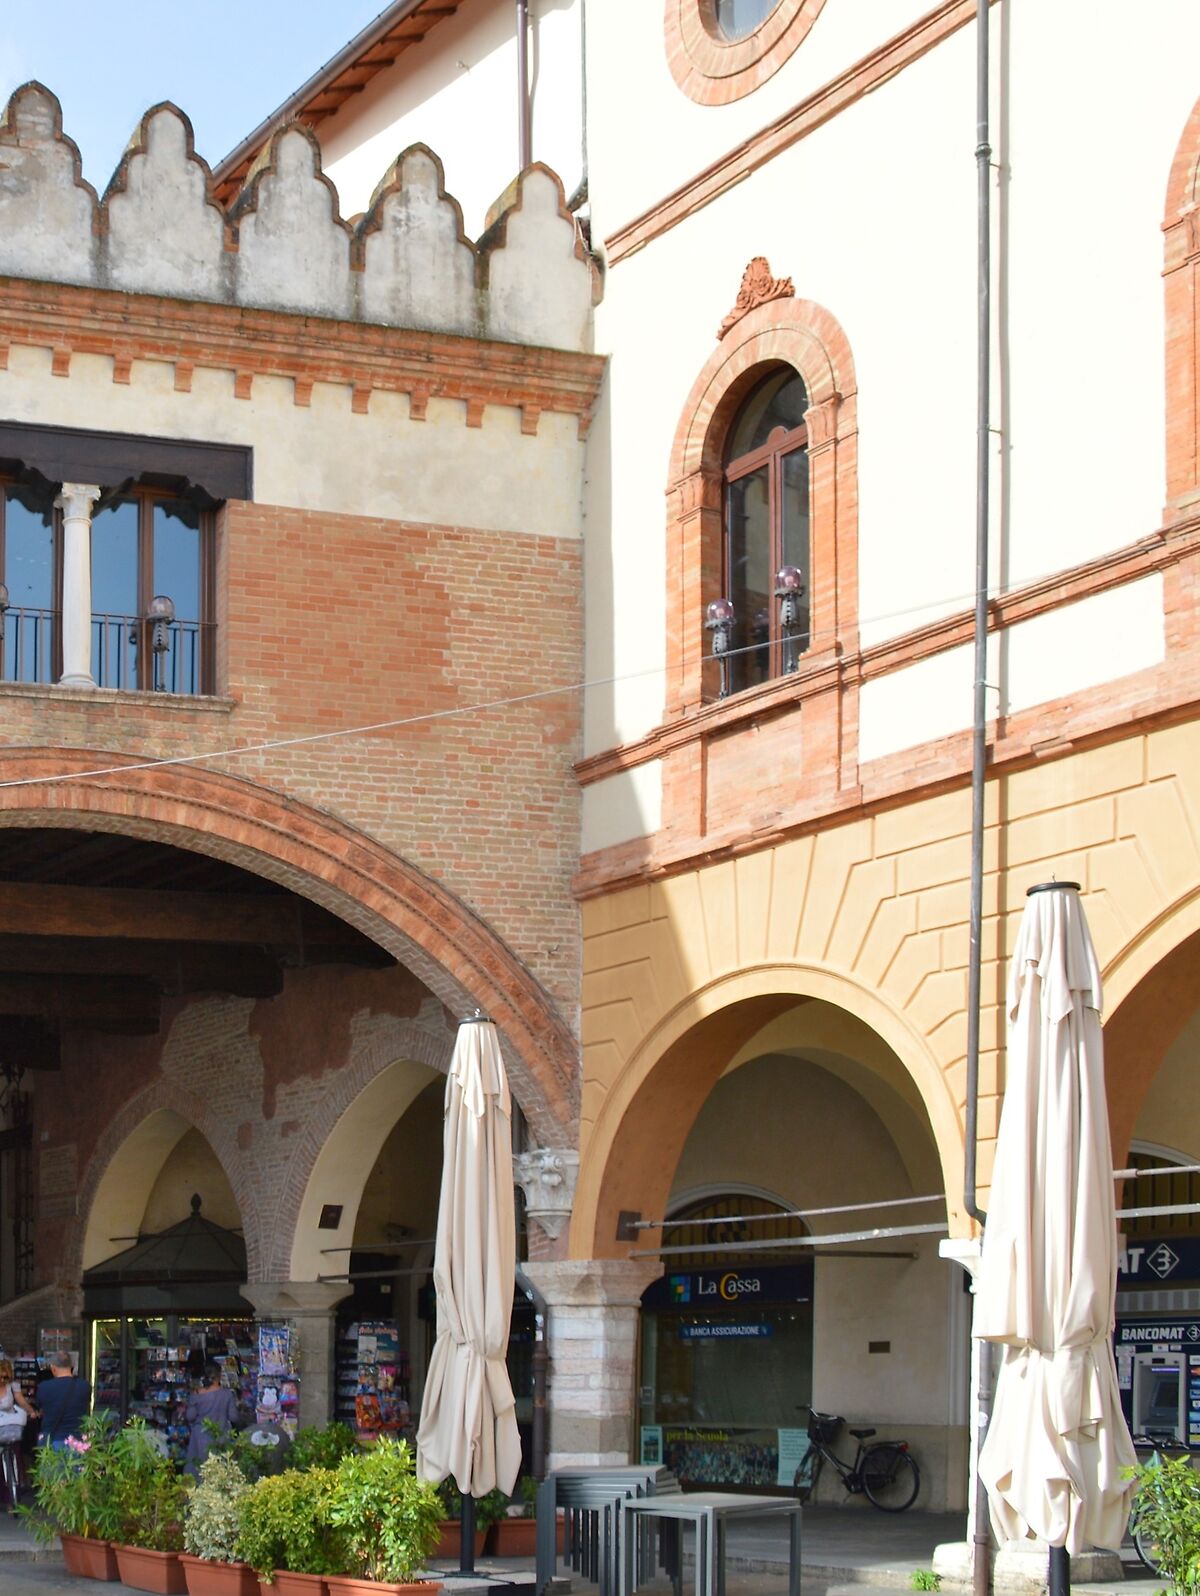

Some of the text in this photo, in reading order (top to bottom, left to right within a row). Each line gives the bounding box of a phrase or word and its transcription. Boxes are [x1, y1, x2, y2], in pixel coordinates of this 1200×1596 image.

[698, 1273, 761, 1300] La Cassa
[689, 1325, 760, 1337] BANCA ASSICURAZIONE
[1121, 1327, 1185, 1341] BANCOMAT
[695, 1429, 729, 1442] Scuola
